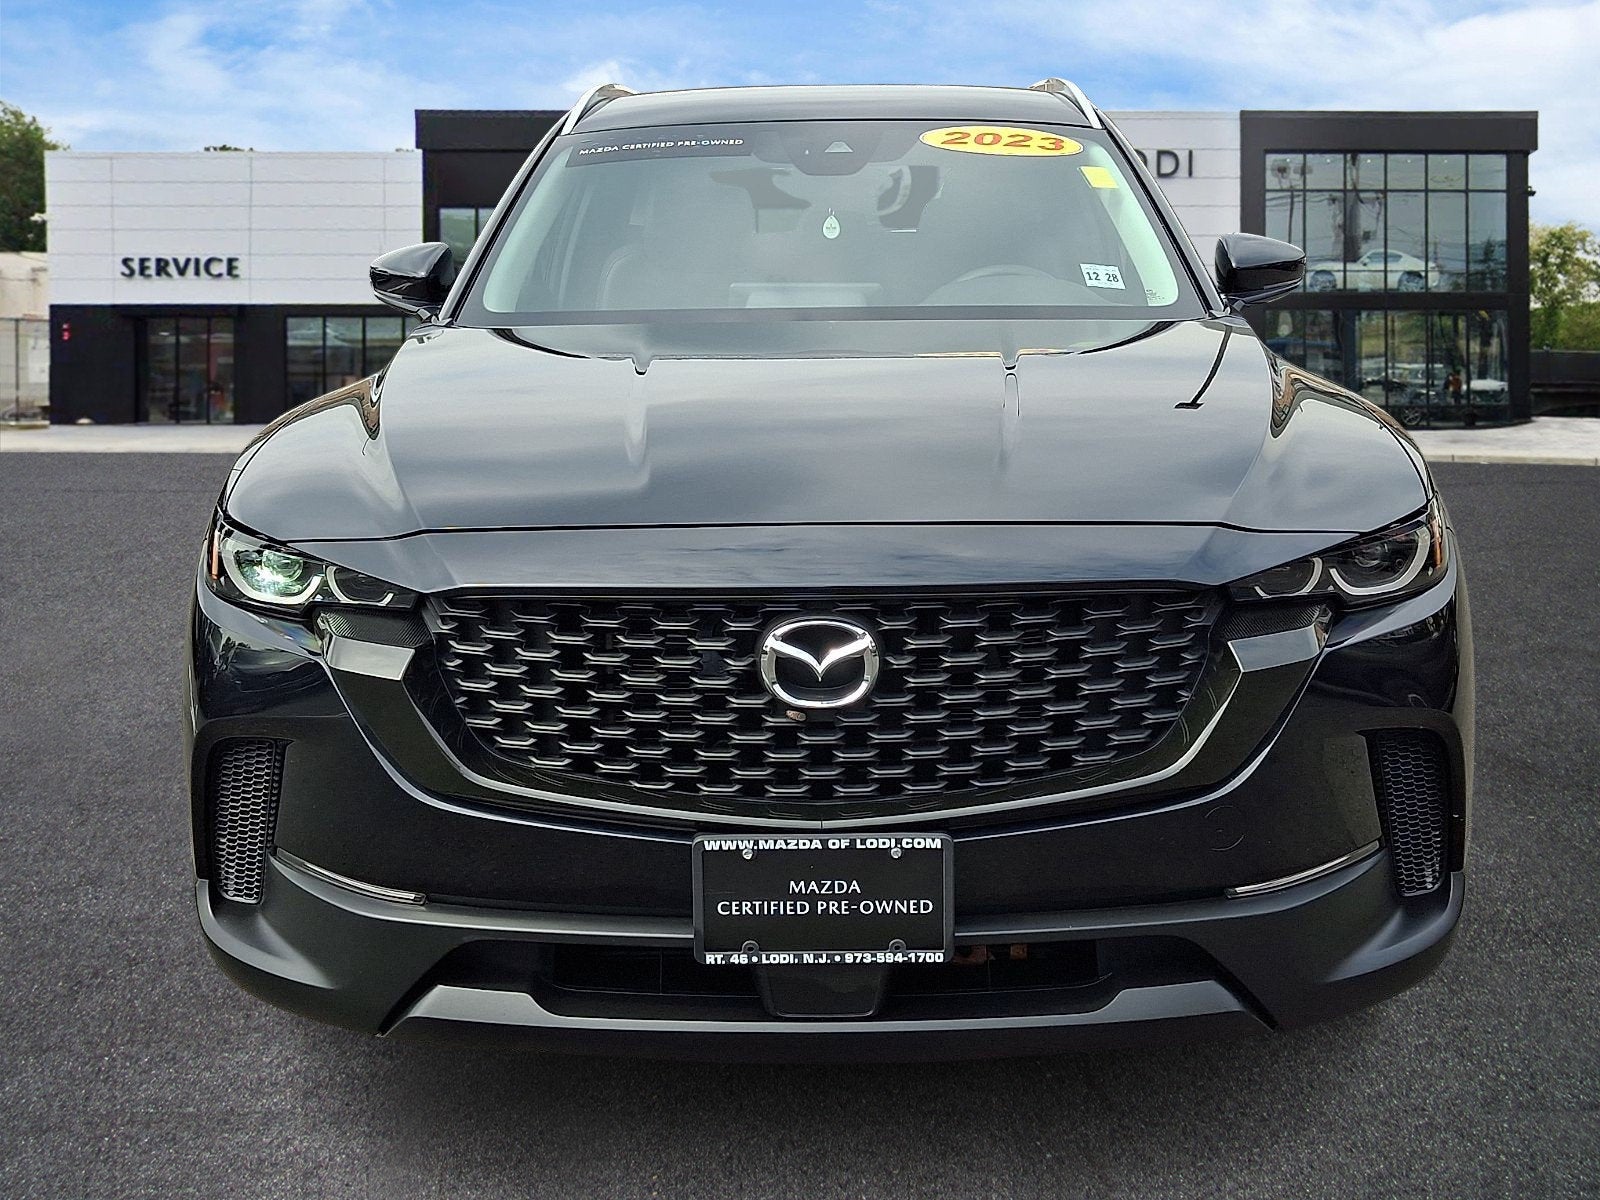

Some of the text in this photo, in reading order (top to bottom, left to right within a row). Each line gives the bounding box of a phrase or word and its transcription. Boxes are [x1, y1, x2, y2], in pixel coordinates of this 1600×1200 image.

[579, 139, 744, 155] MAZDA CERTIFIED PRE-OWNED
[941, 131, 1065, 151] 2023
[121, 257, 240, 279] SERVICE
[1086, 271, 1120, 283] 12 28
[704, 838, 942, 850] WWW.MAZDA OF LODI.COM
[789, 880, 861, 894] MAZDA
[717, 900, 933, 915] CERTIFIED PRE-OWNED
[705, 954, 726, 965] RT.
[730, 954, 748, 964] 46
[803, 953, 831, 963] N.J.
[845, 952, 944, 963] 973-594-1700
